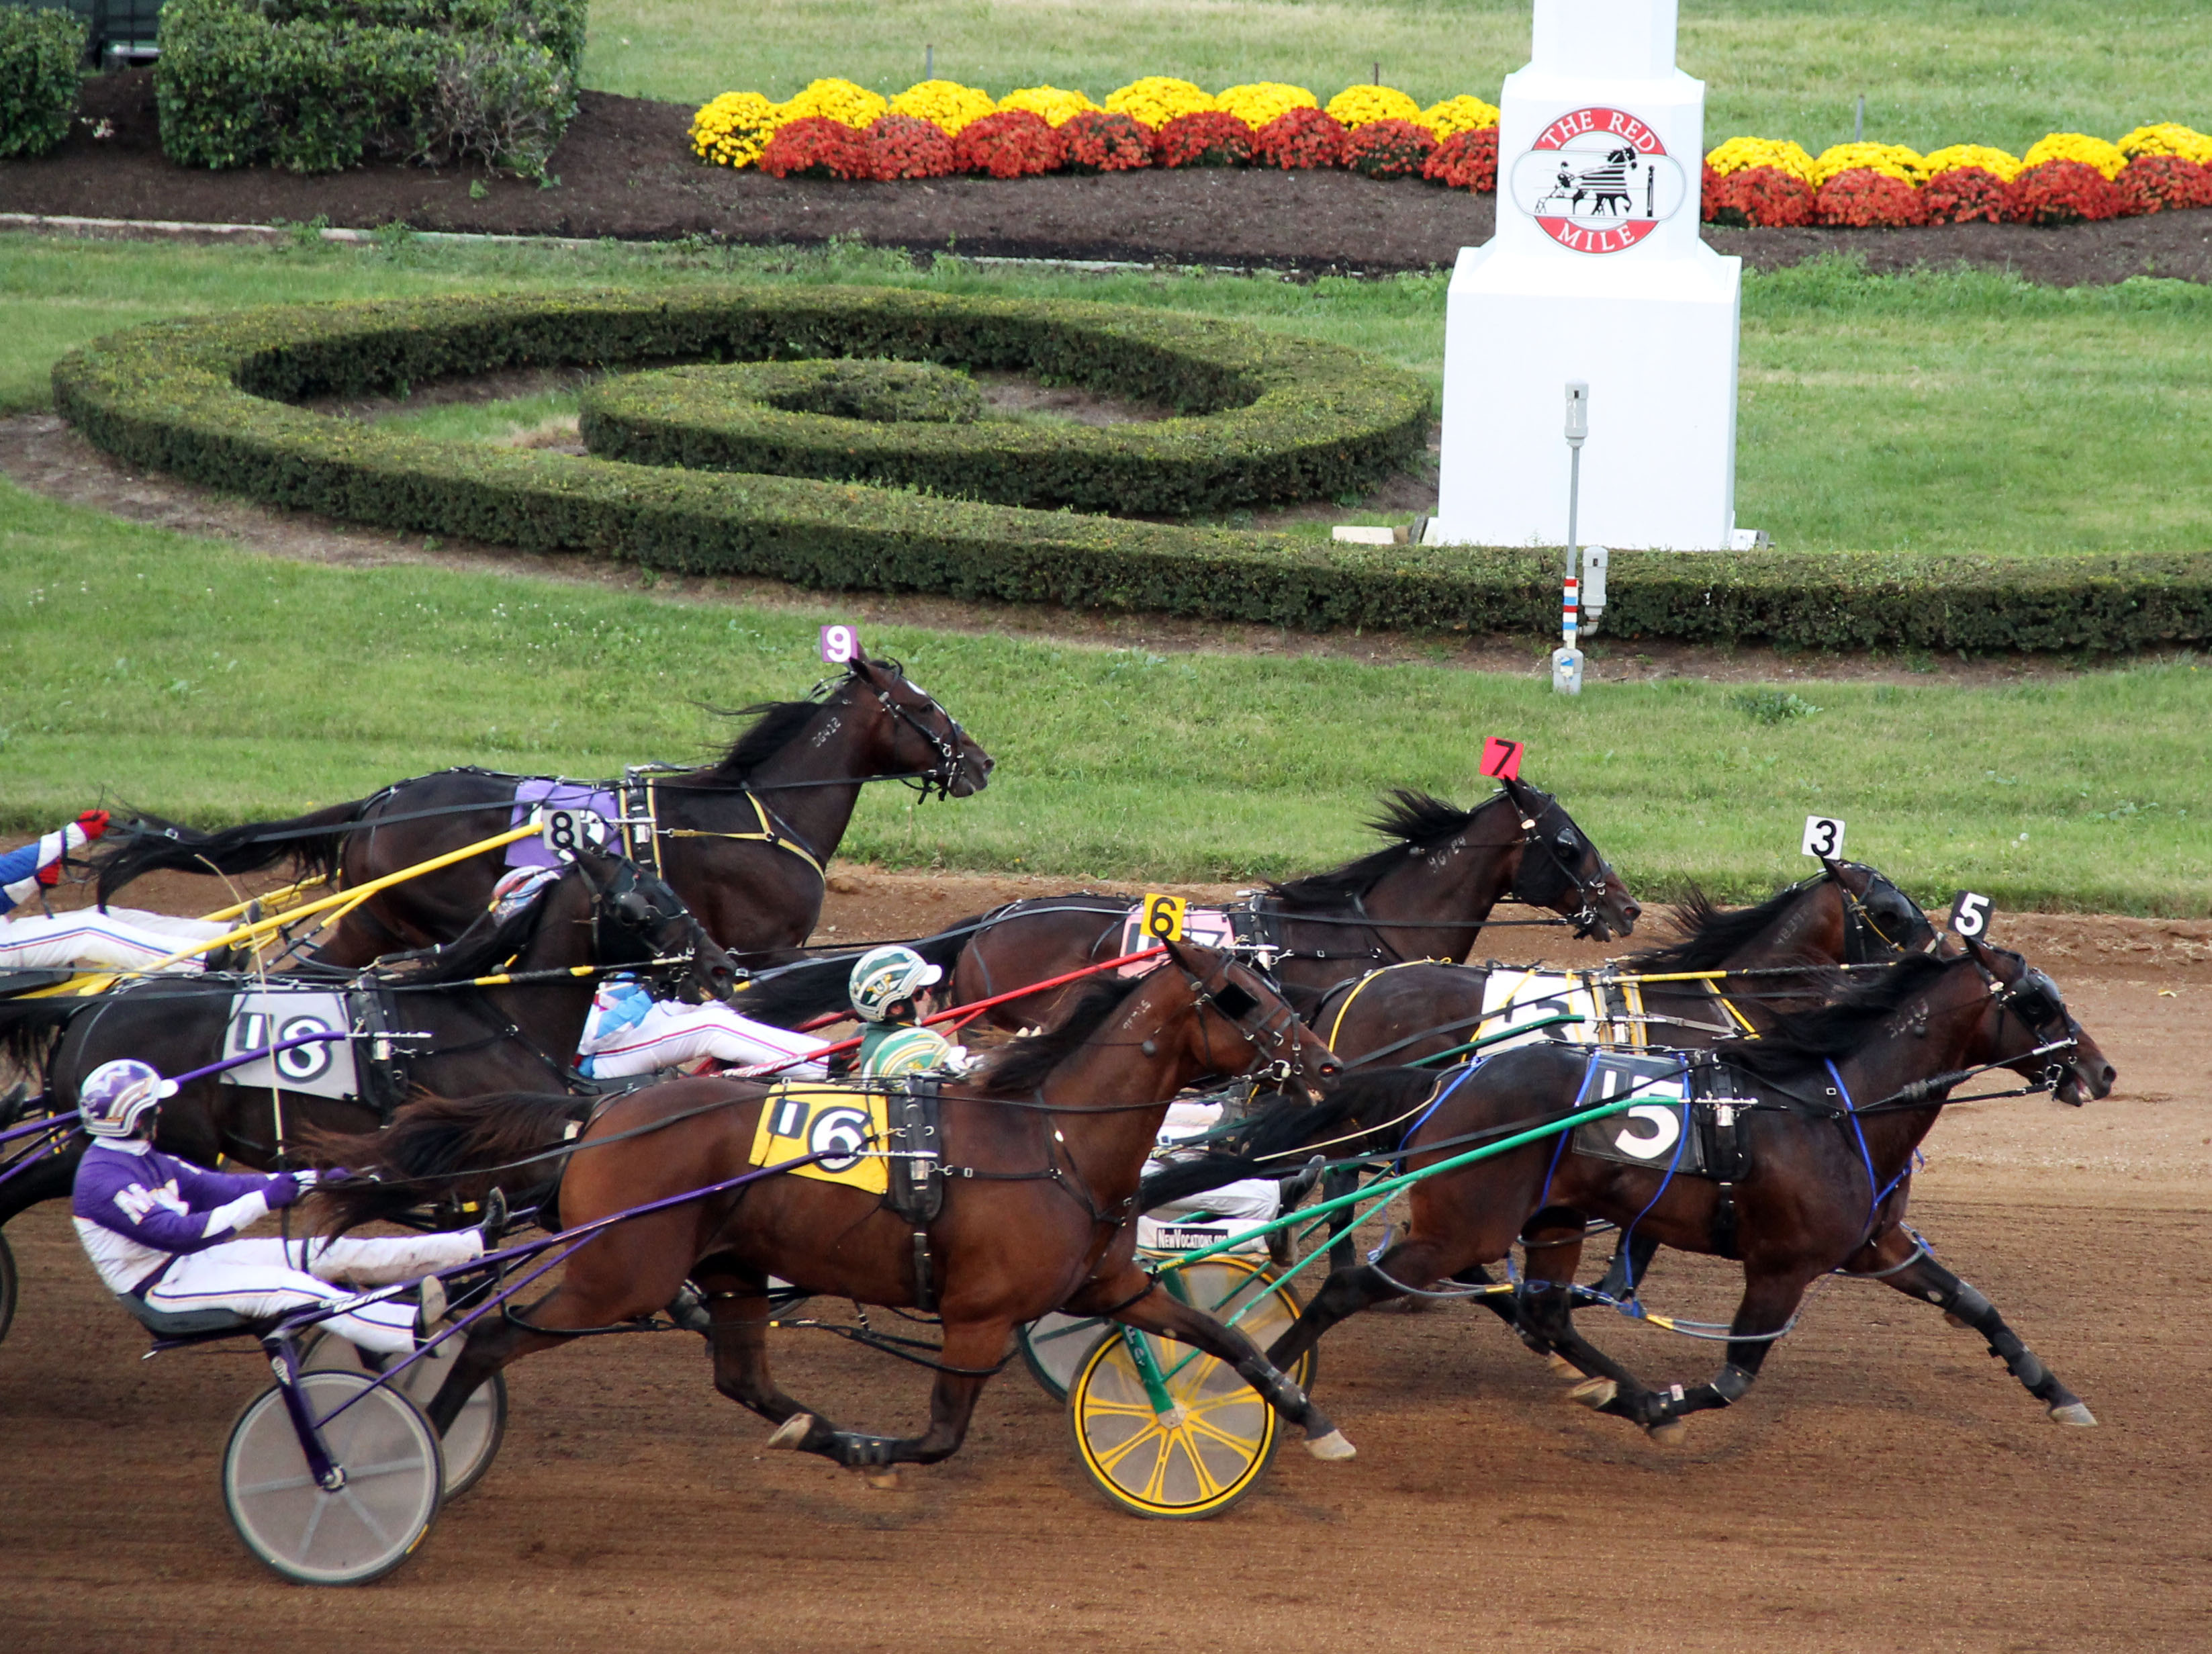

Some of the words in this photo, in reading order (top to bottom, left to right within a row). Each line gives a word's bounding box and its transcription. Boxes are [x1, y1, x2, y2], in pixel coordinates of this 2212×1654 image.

[1542, 111, 1594, 149] THE
[1608, 111, 1656, 152] RED
[1558, 223, 1634, 251] MILE
[826, 625, 851, 662] 9
[1492, 739, 1516, 776] 7
[551, 811, 575, 849] 8
[1811, 820, 1837, 857] 3
[1150, 897, 1177, 937] 6
[1955, 892, 1990, 936] 5
